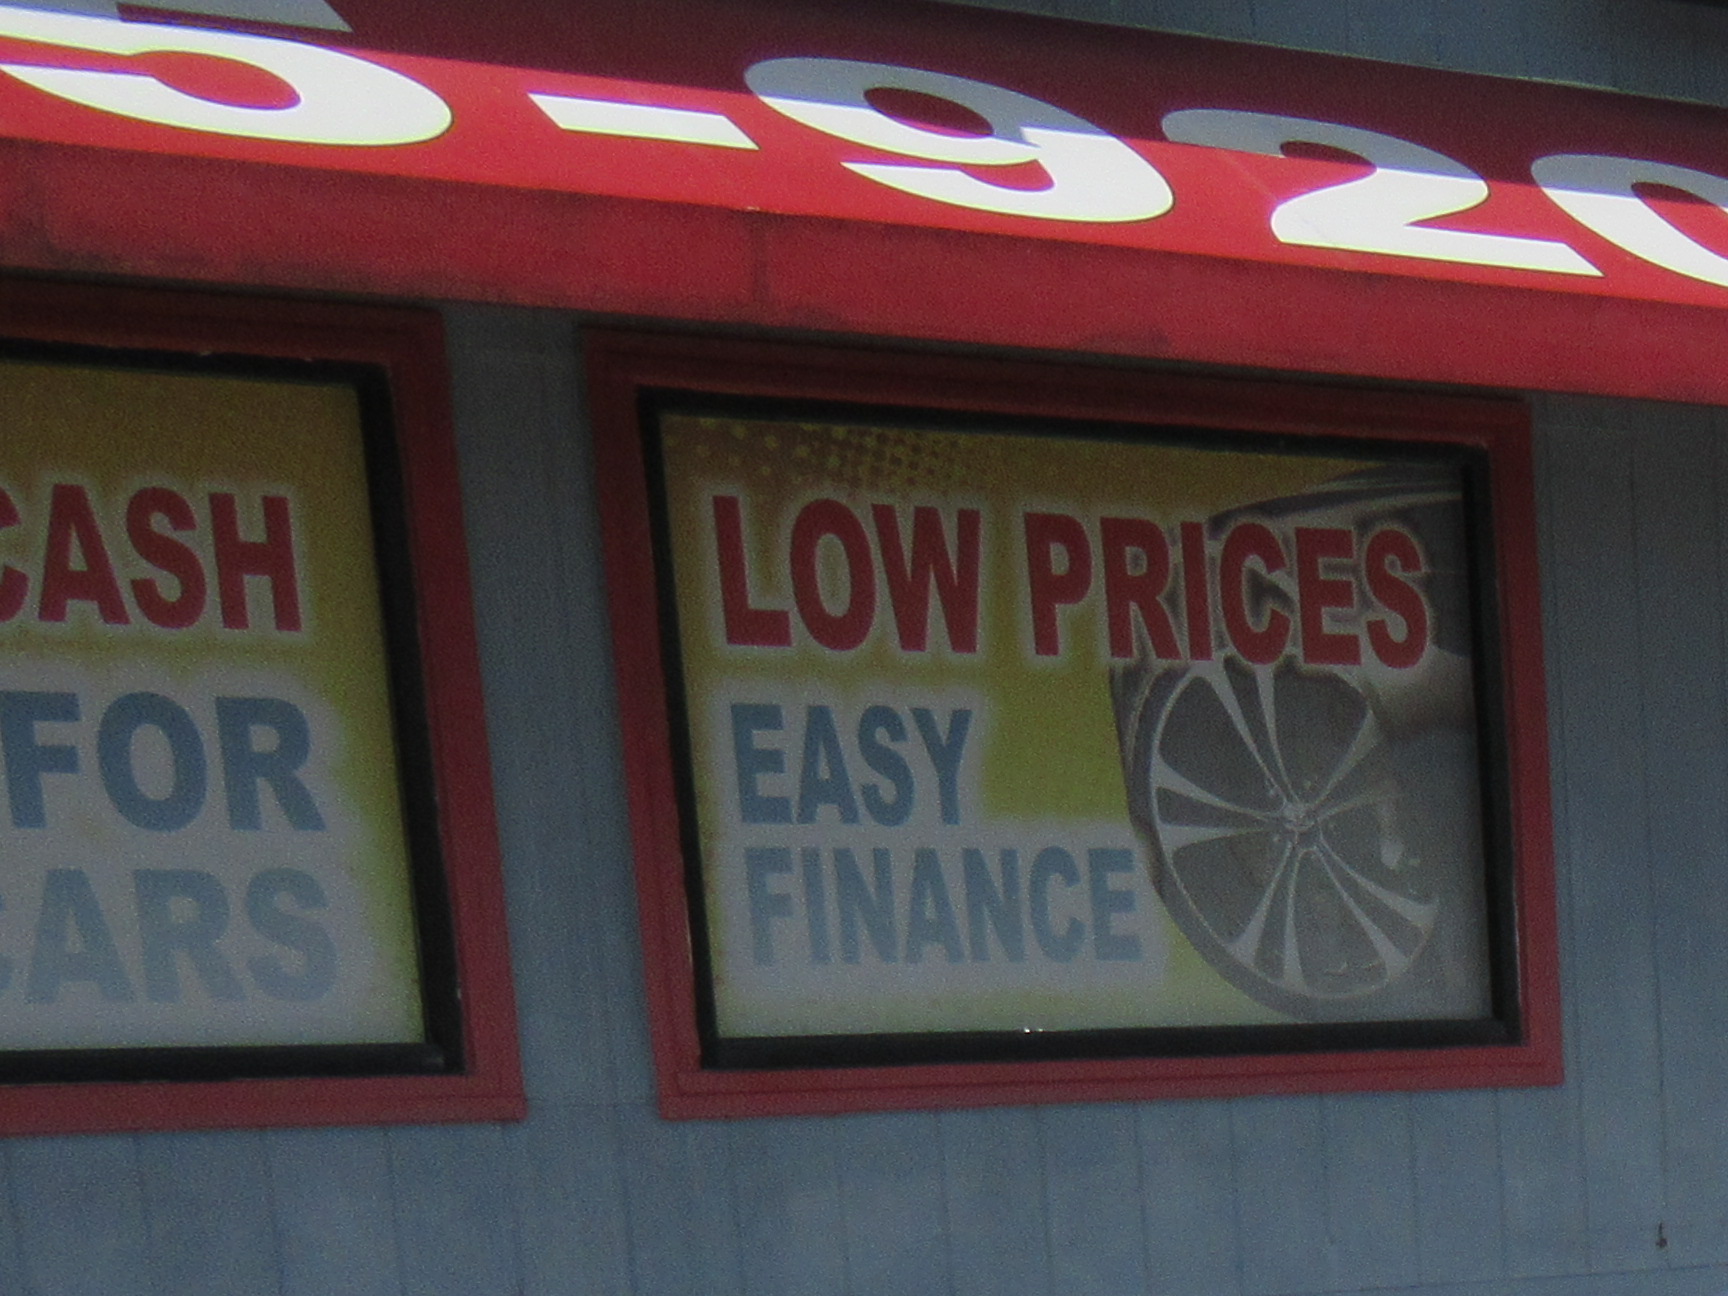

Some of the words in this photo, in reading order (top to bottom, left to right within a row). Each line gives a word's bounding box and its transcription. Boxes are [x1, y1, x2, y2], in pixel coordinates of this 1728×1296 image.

[0, 484, 303, 632] ASH
[712, 494, 980, 652] LOW
[1022, 510, 1430, 669] PRICES
[0, 690, 328, 833] FOR
[728, 702, 975, 826] EASY
[0, 868, 340, 1002] ARS
[745, 846, 1145, 965] FINANCE
